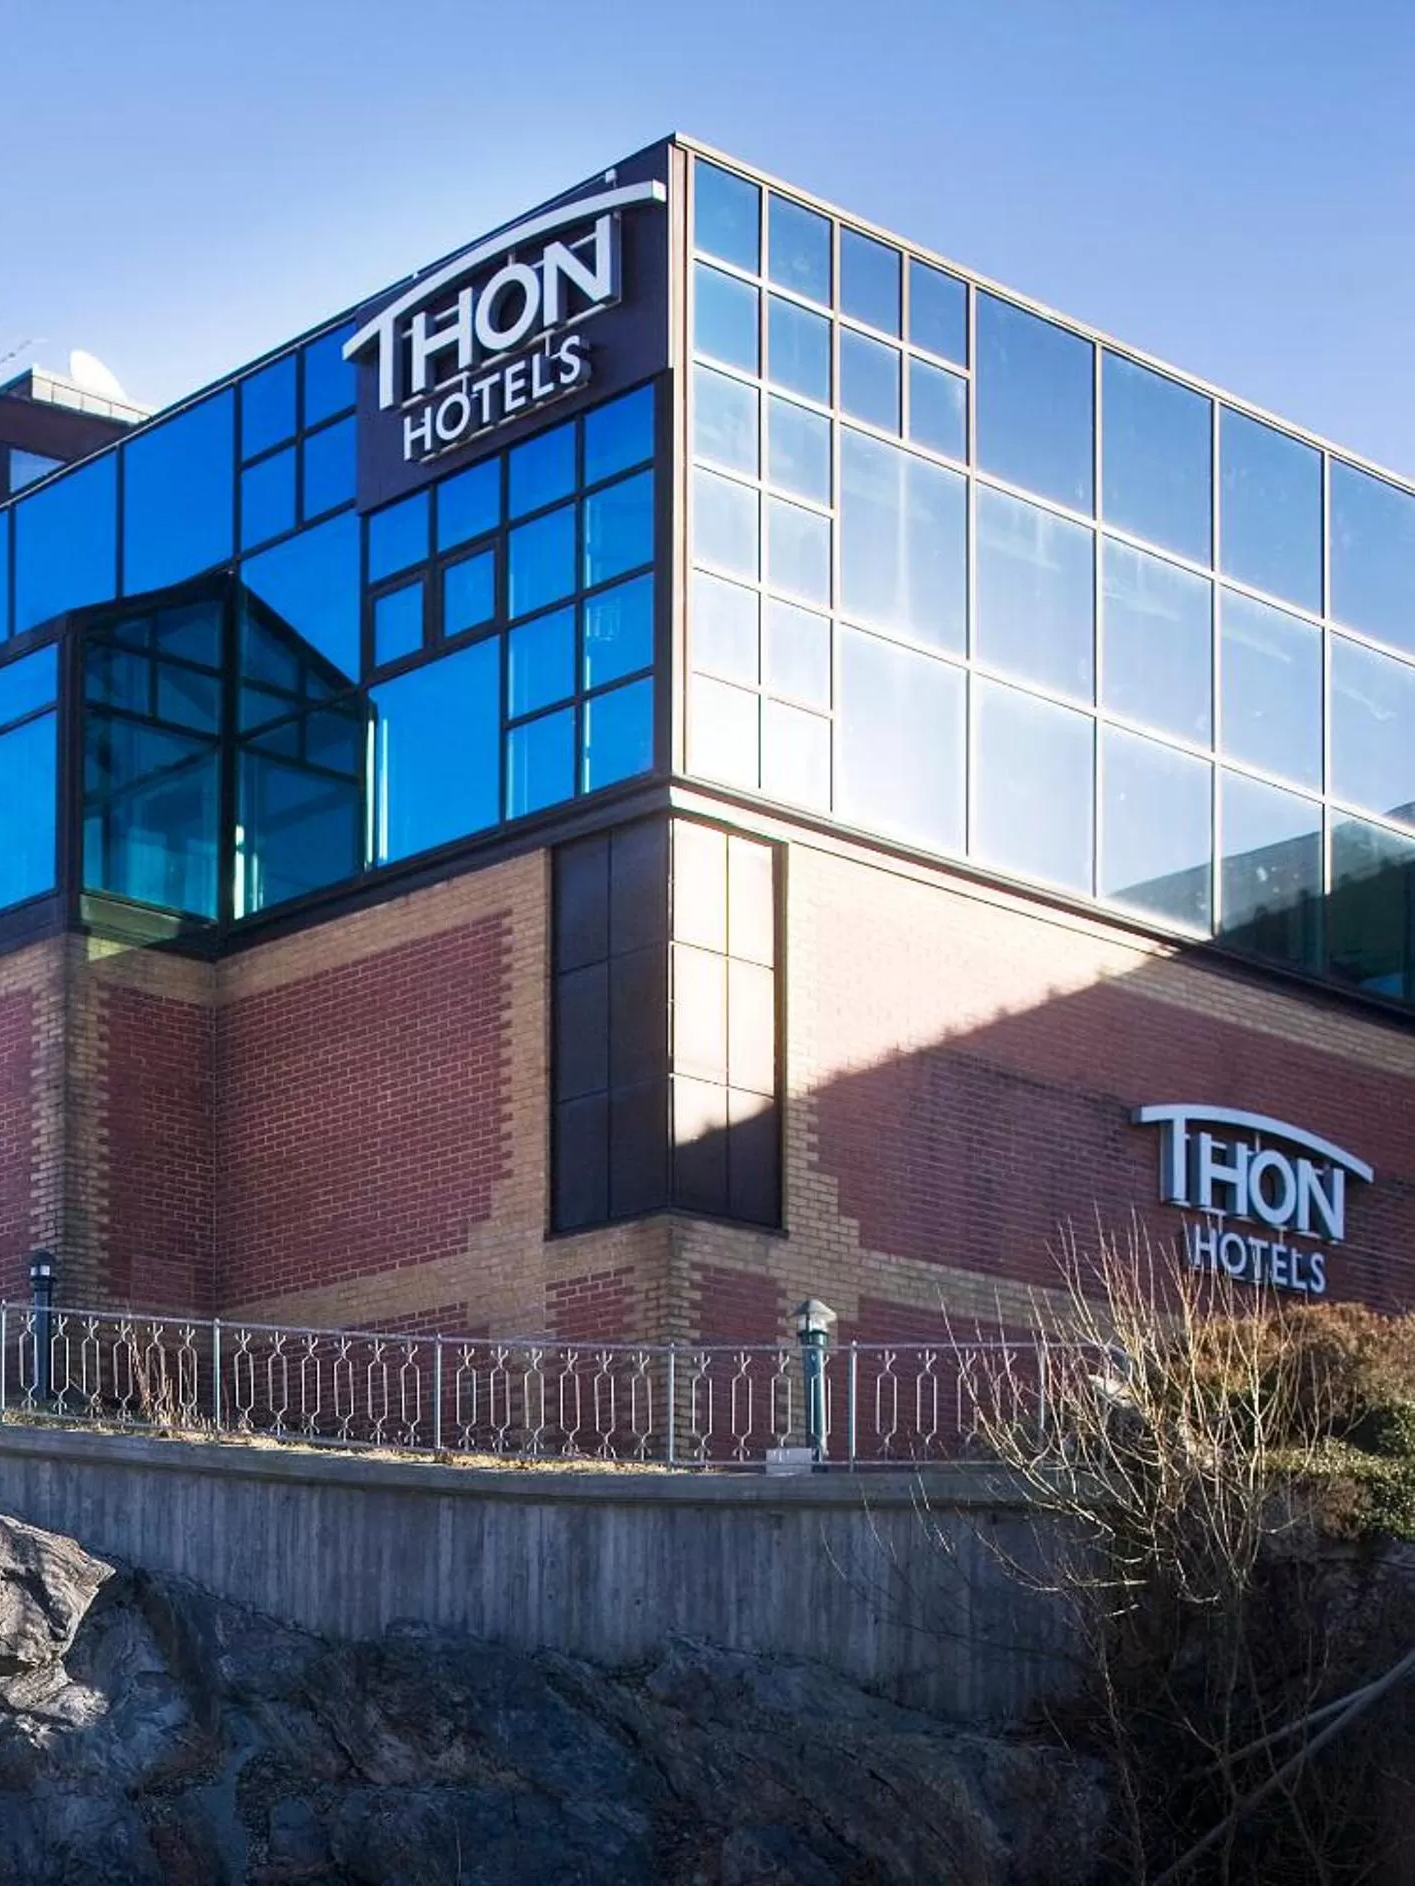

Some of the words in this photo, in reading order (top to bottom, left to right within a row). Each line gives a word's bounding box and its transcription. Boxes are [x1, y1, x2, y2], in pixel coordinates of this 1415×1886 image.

[342, 179, 667, 411] THON
[403, 334, 583, 462] HOTELS
[1139, 1103, 1374, 1241] THON
[1190, 1223, 1327, 1294] HOTELS
